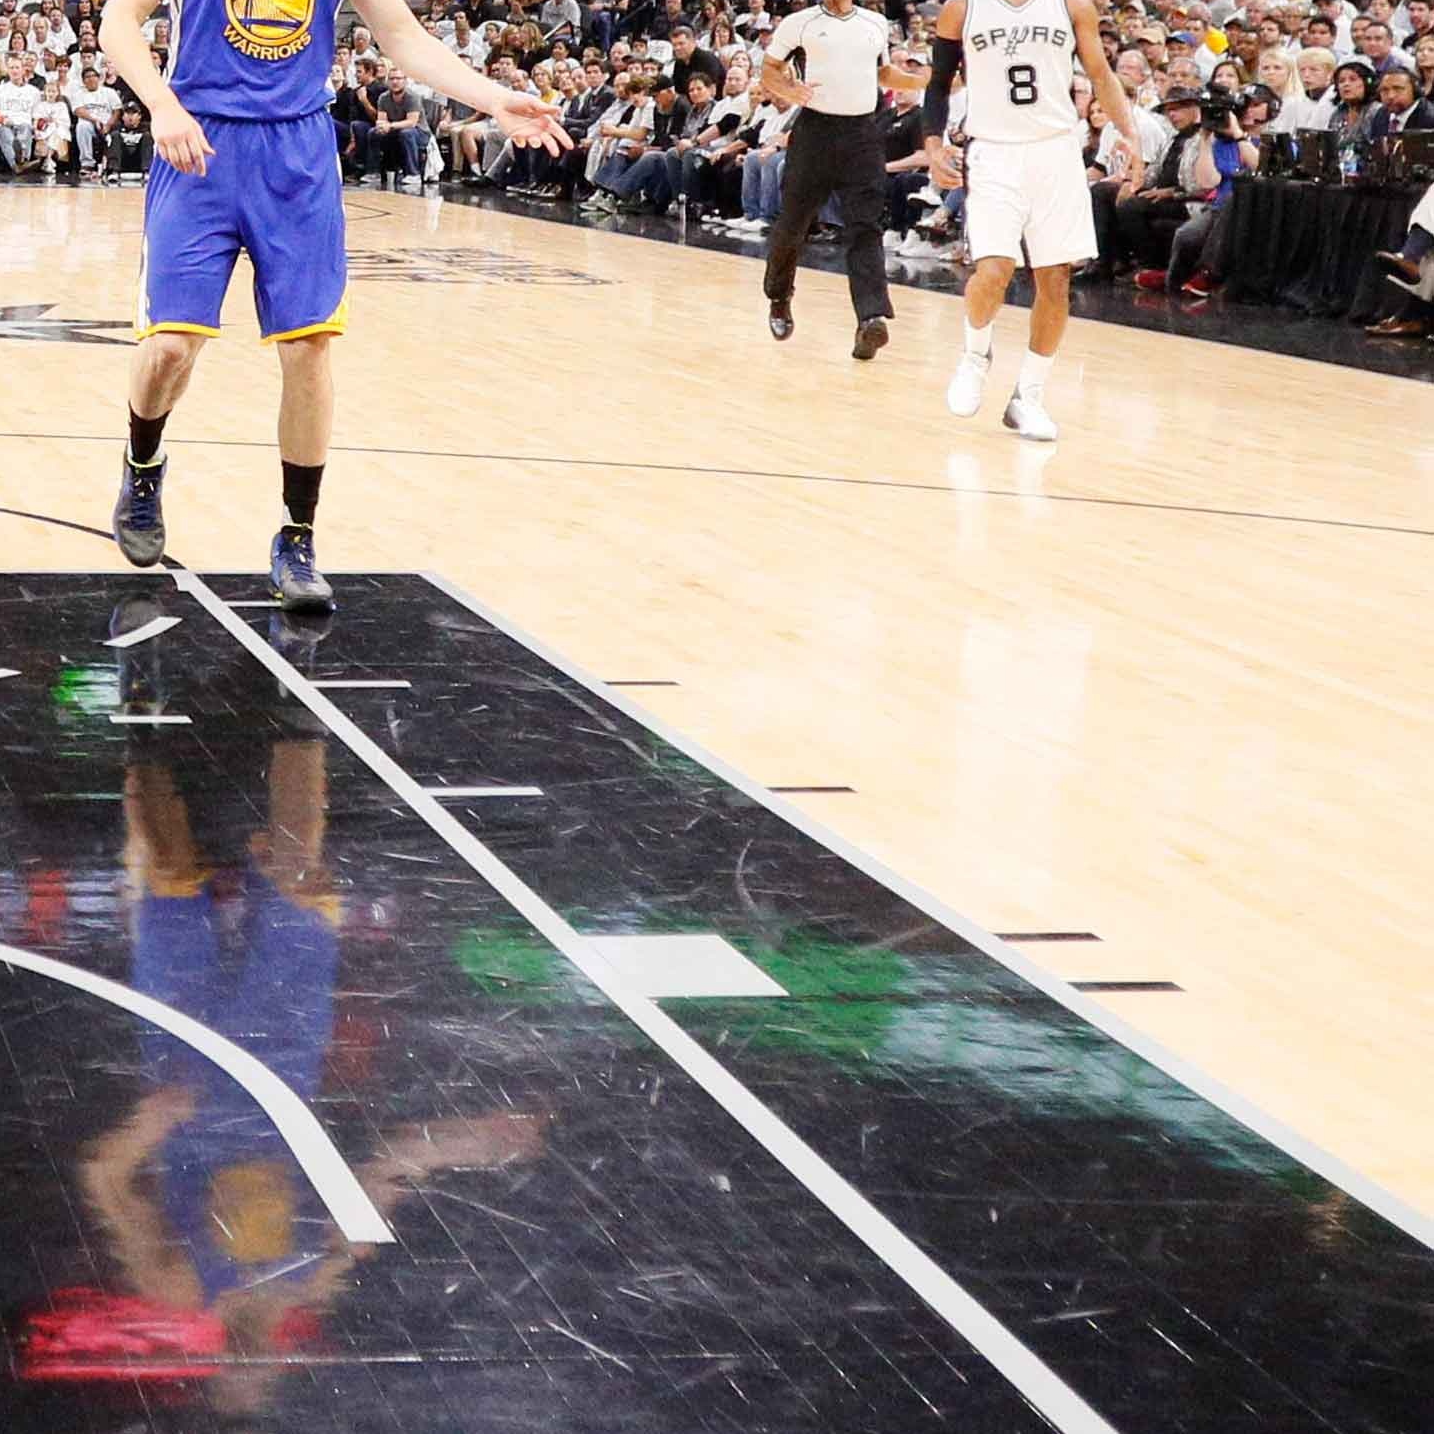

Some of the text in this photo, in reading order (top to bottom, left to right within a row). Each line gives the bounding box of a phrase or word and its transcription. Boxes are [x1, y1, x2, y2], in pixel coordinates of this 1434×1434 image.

[223, 23, 313, 61] WARRIORS
[970, 22, 1069, 56] SPURS
[1007, 65, 1038, 106] 8
